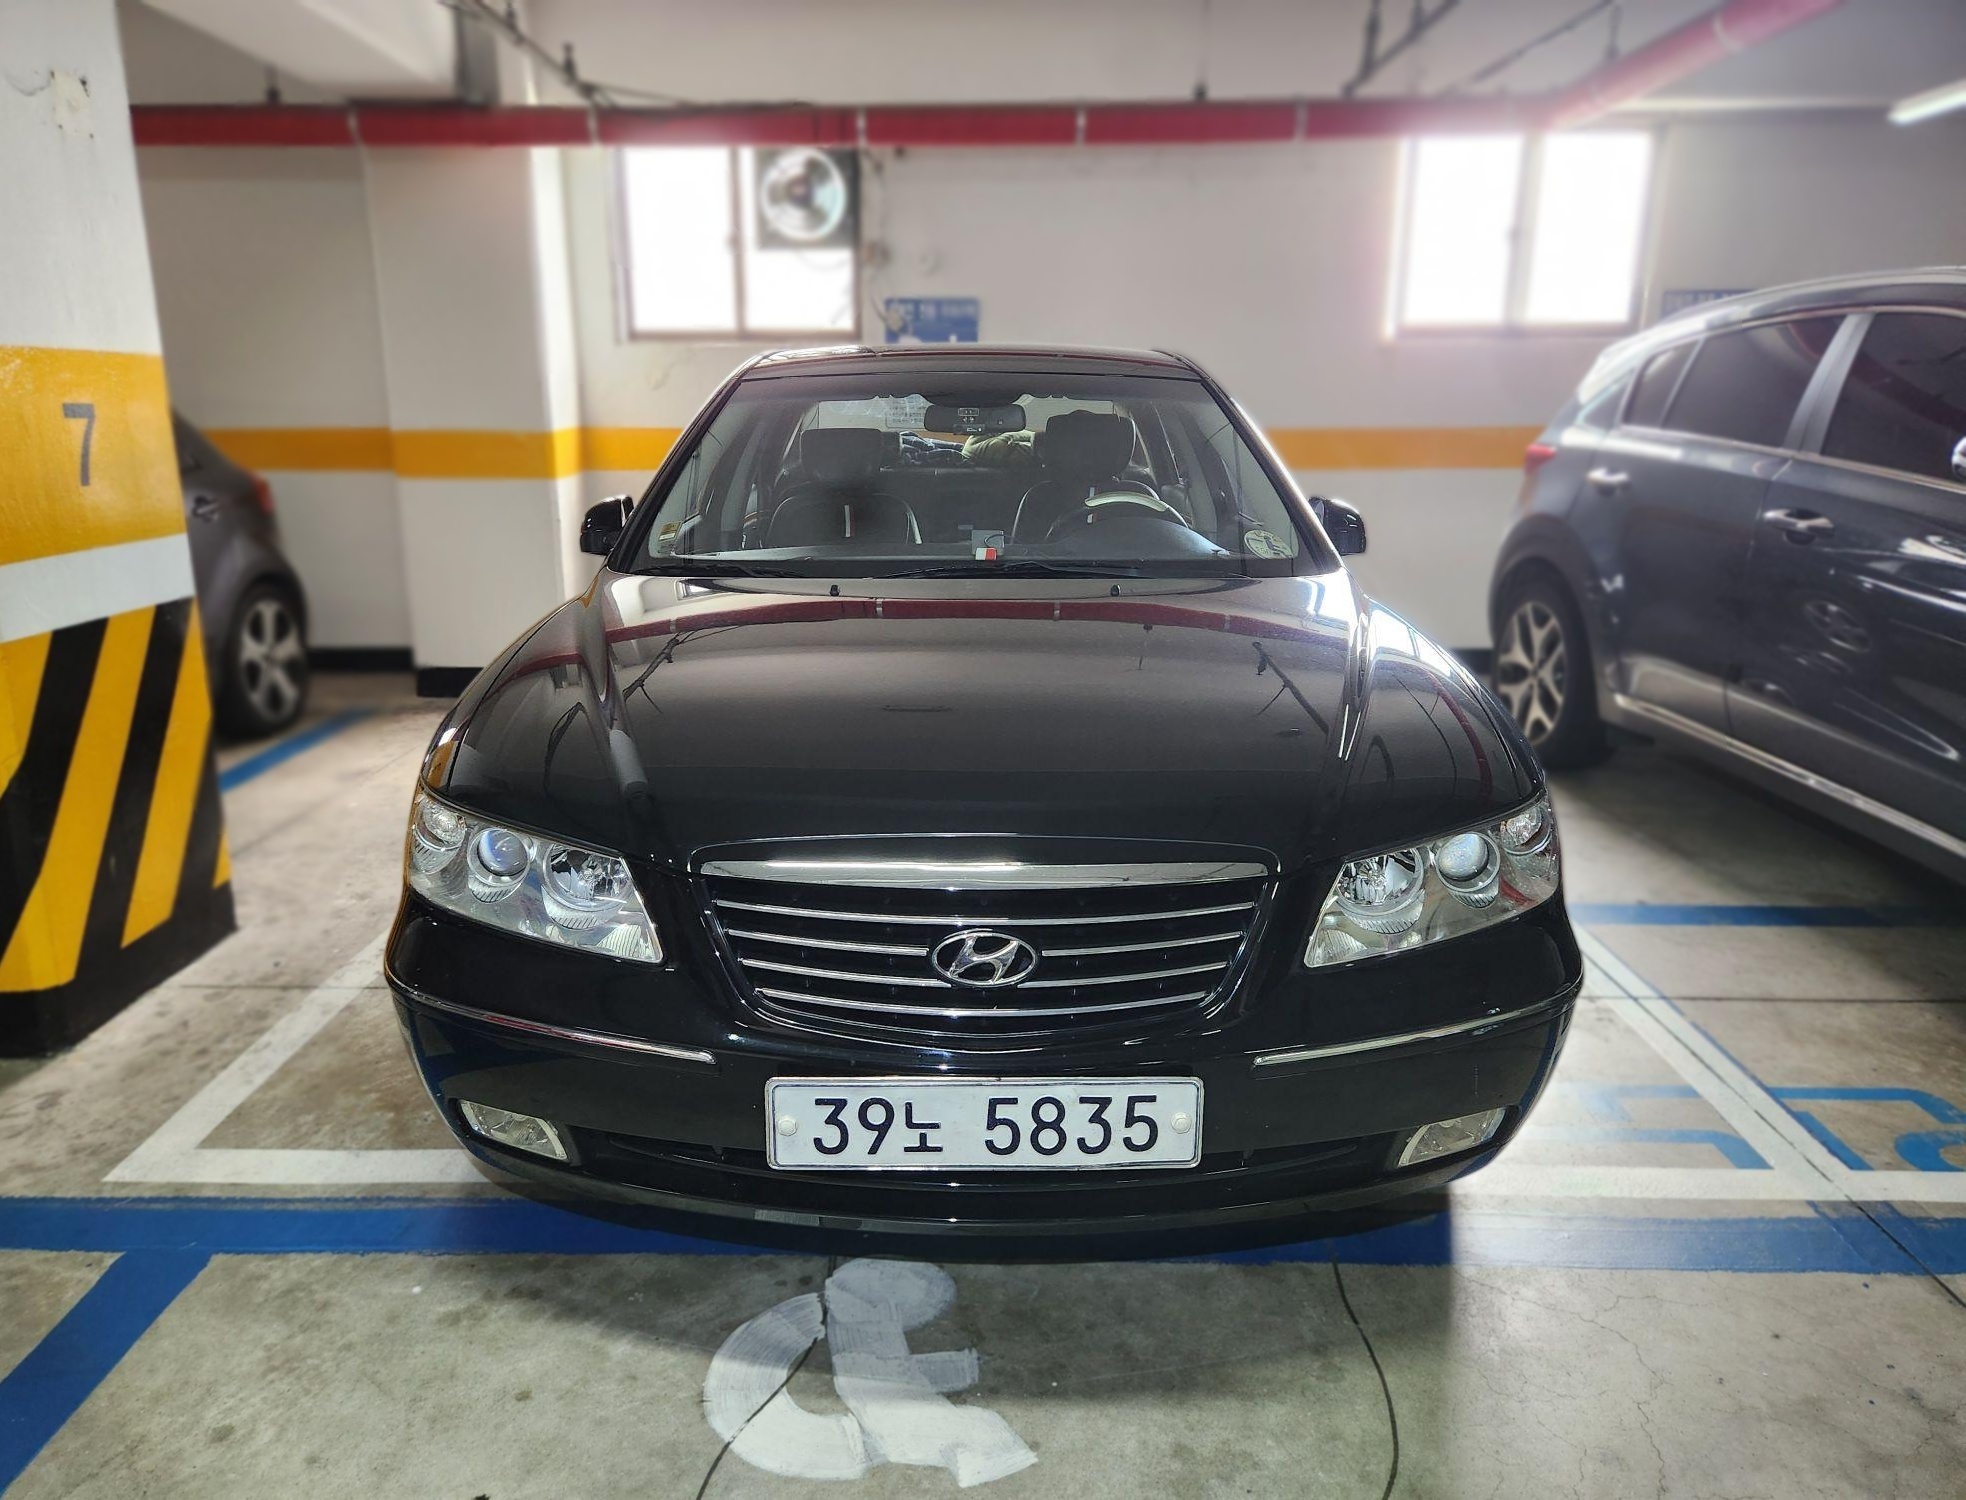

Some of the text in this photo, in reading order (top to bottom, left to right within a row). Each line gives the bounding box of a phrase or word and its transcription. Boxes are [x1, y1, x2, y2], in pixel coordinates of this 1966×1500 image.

[62, 403, 95, 486] 7
[813, 1095, 1158, 1156] 39노 5835
